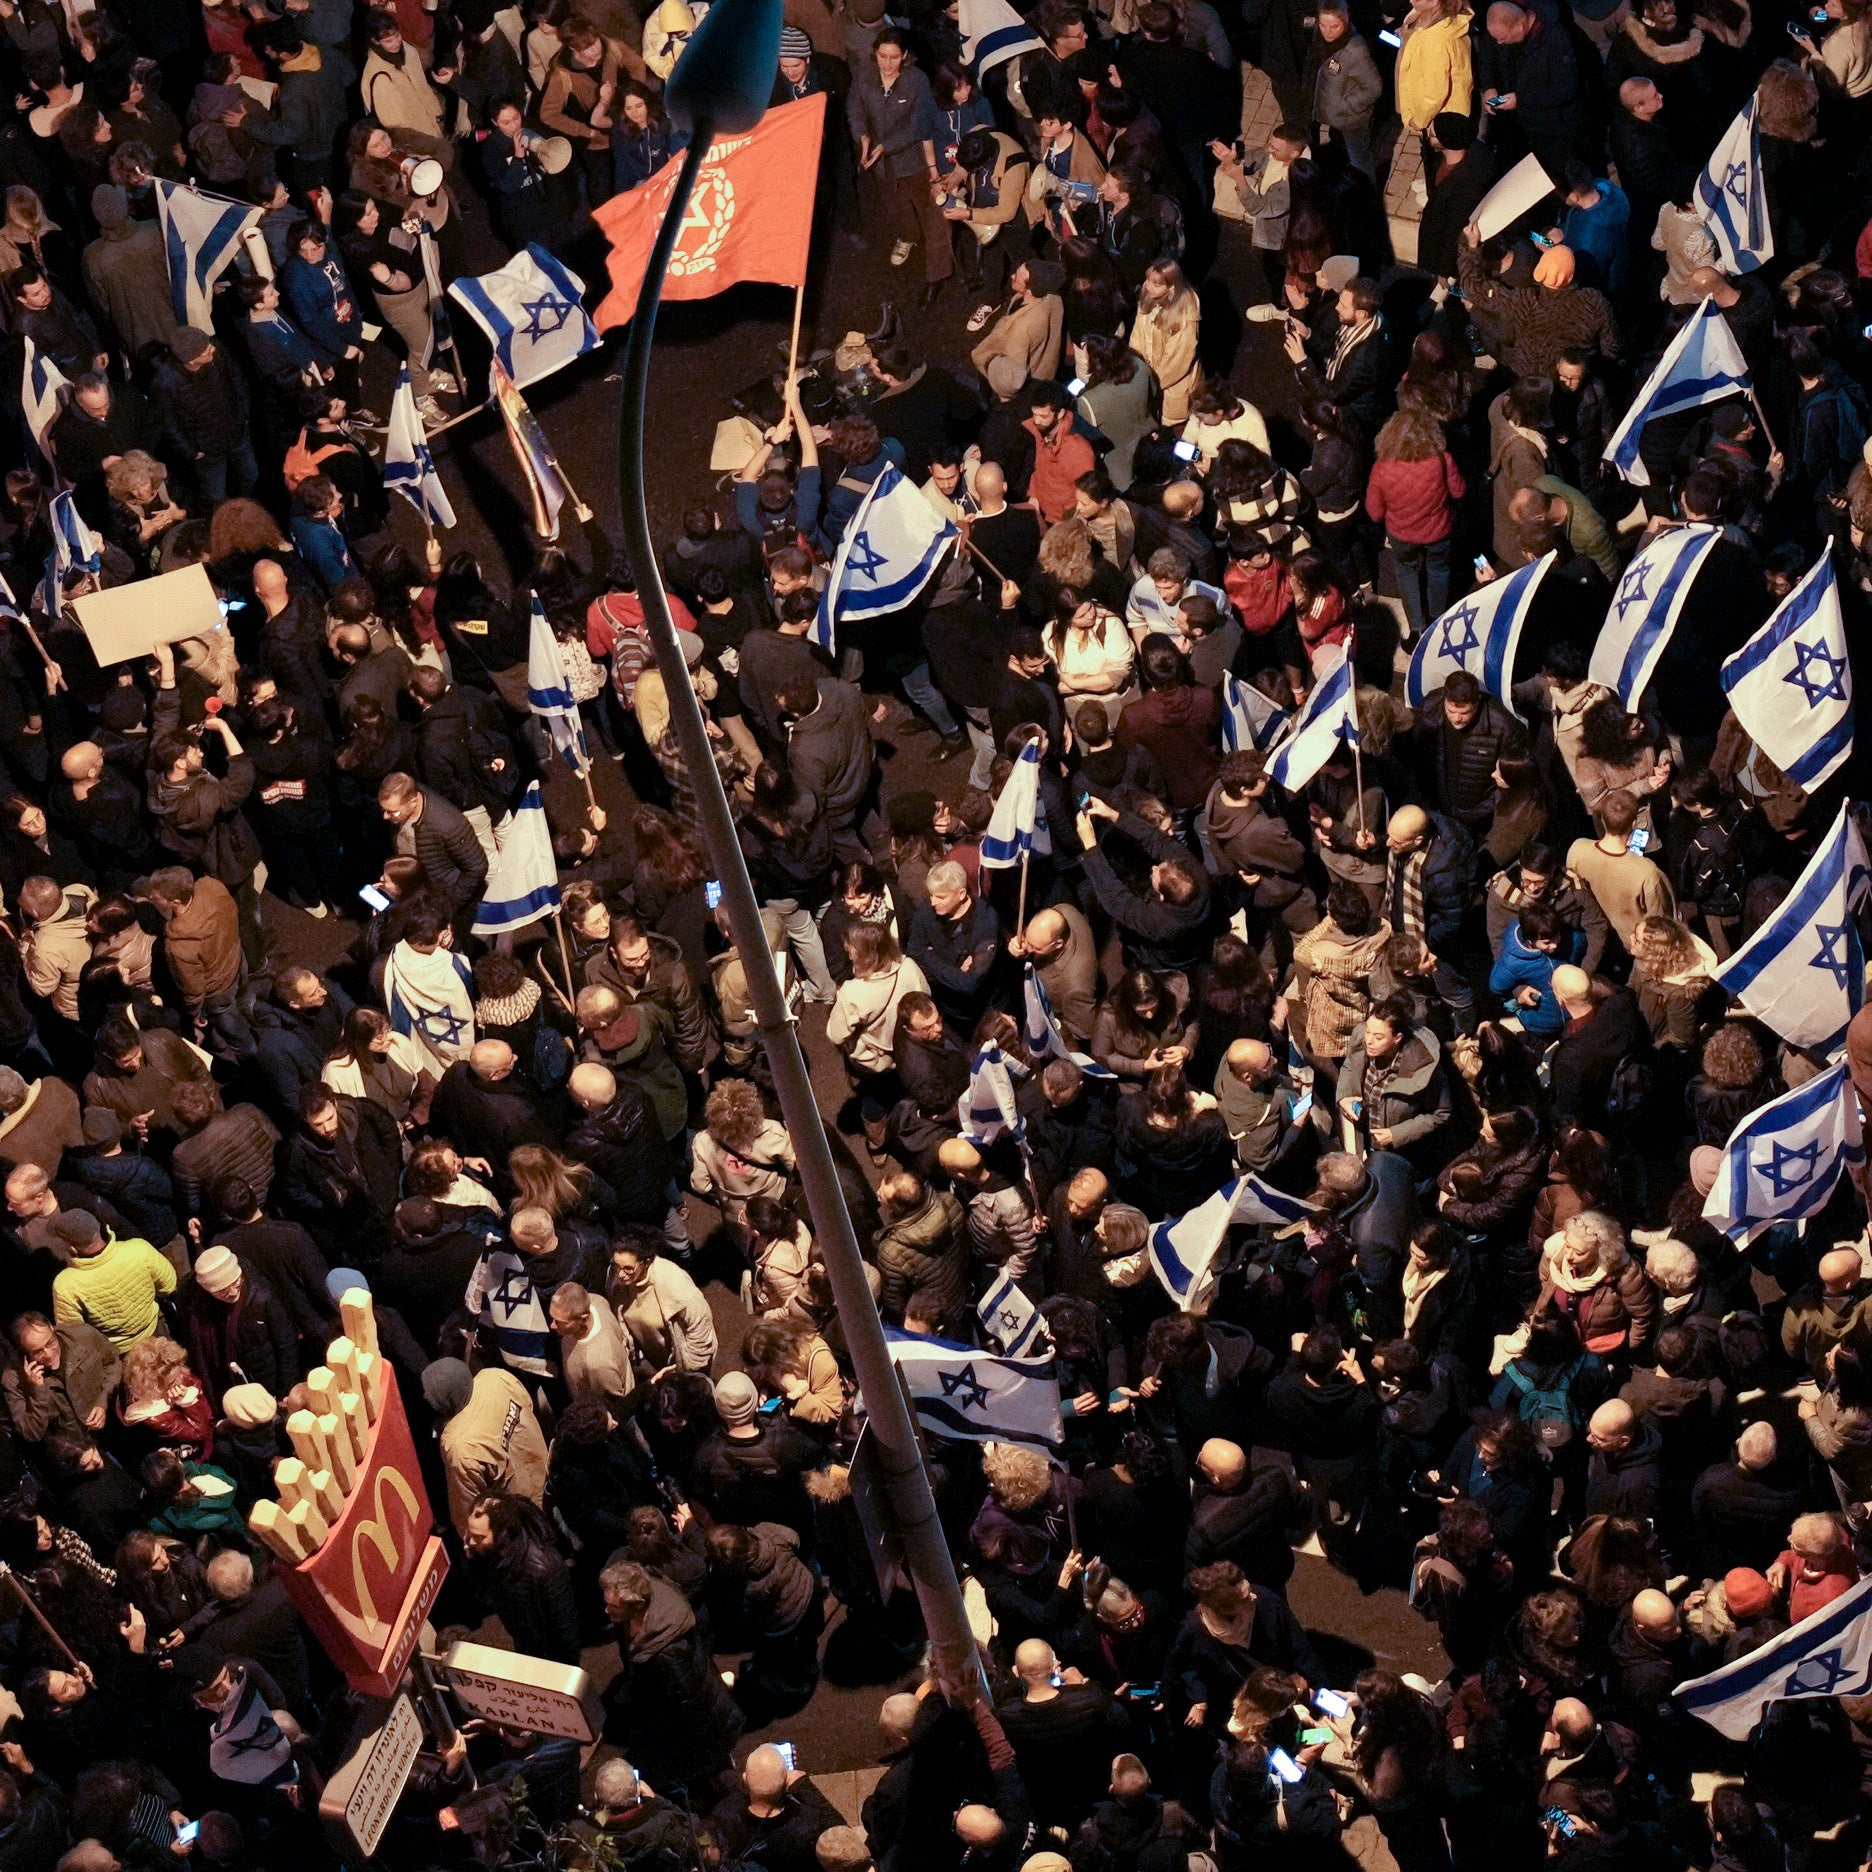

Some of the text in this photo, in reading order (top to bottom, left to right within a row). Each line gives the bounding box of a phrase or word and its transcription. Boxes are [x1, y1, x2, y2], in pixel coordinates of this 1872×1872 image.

[392, 1569, 438, 1670] משלוחים
[456, 1672, 497, 1693] קפלן
[502, 1687, 549, 1704] אליעזר
[467, 1701, 556, 1730] KAPLAN
[364, 1788, 393, 1848] LEONARDO
[390, 1770, 401, 1786] DA
[397, 1741, 414, 1772] VINCI
